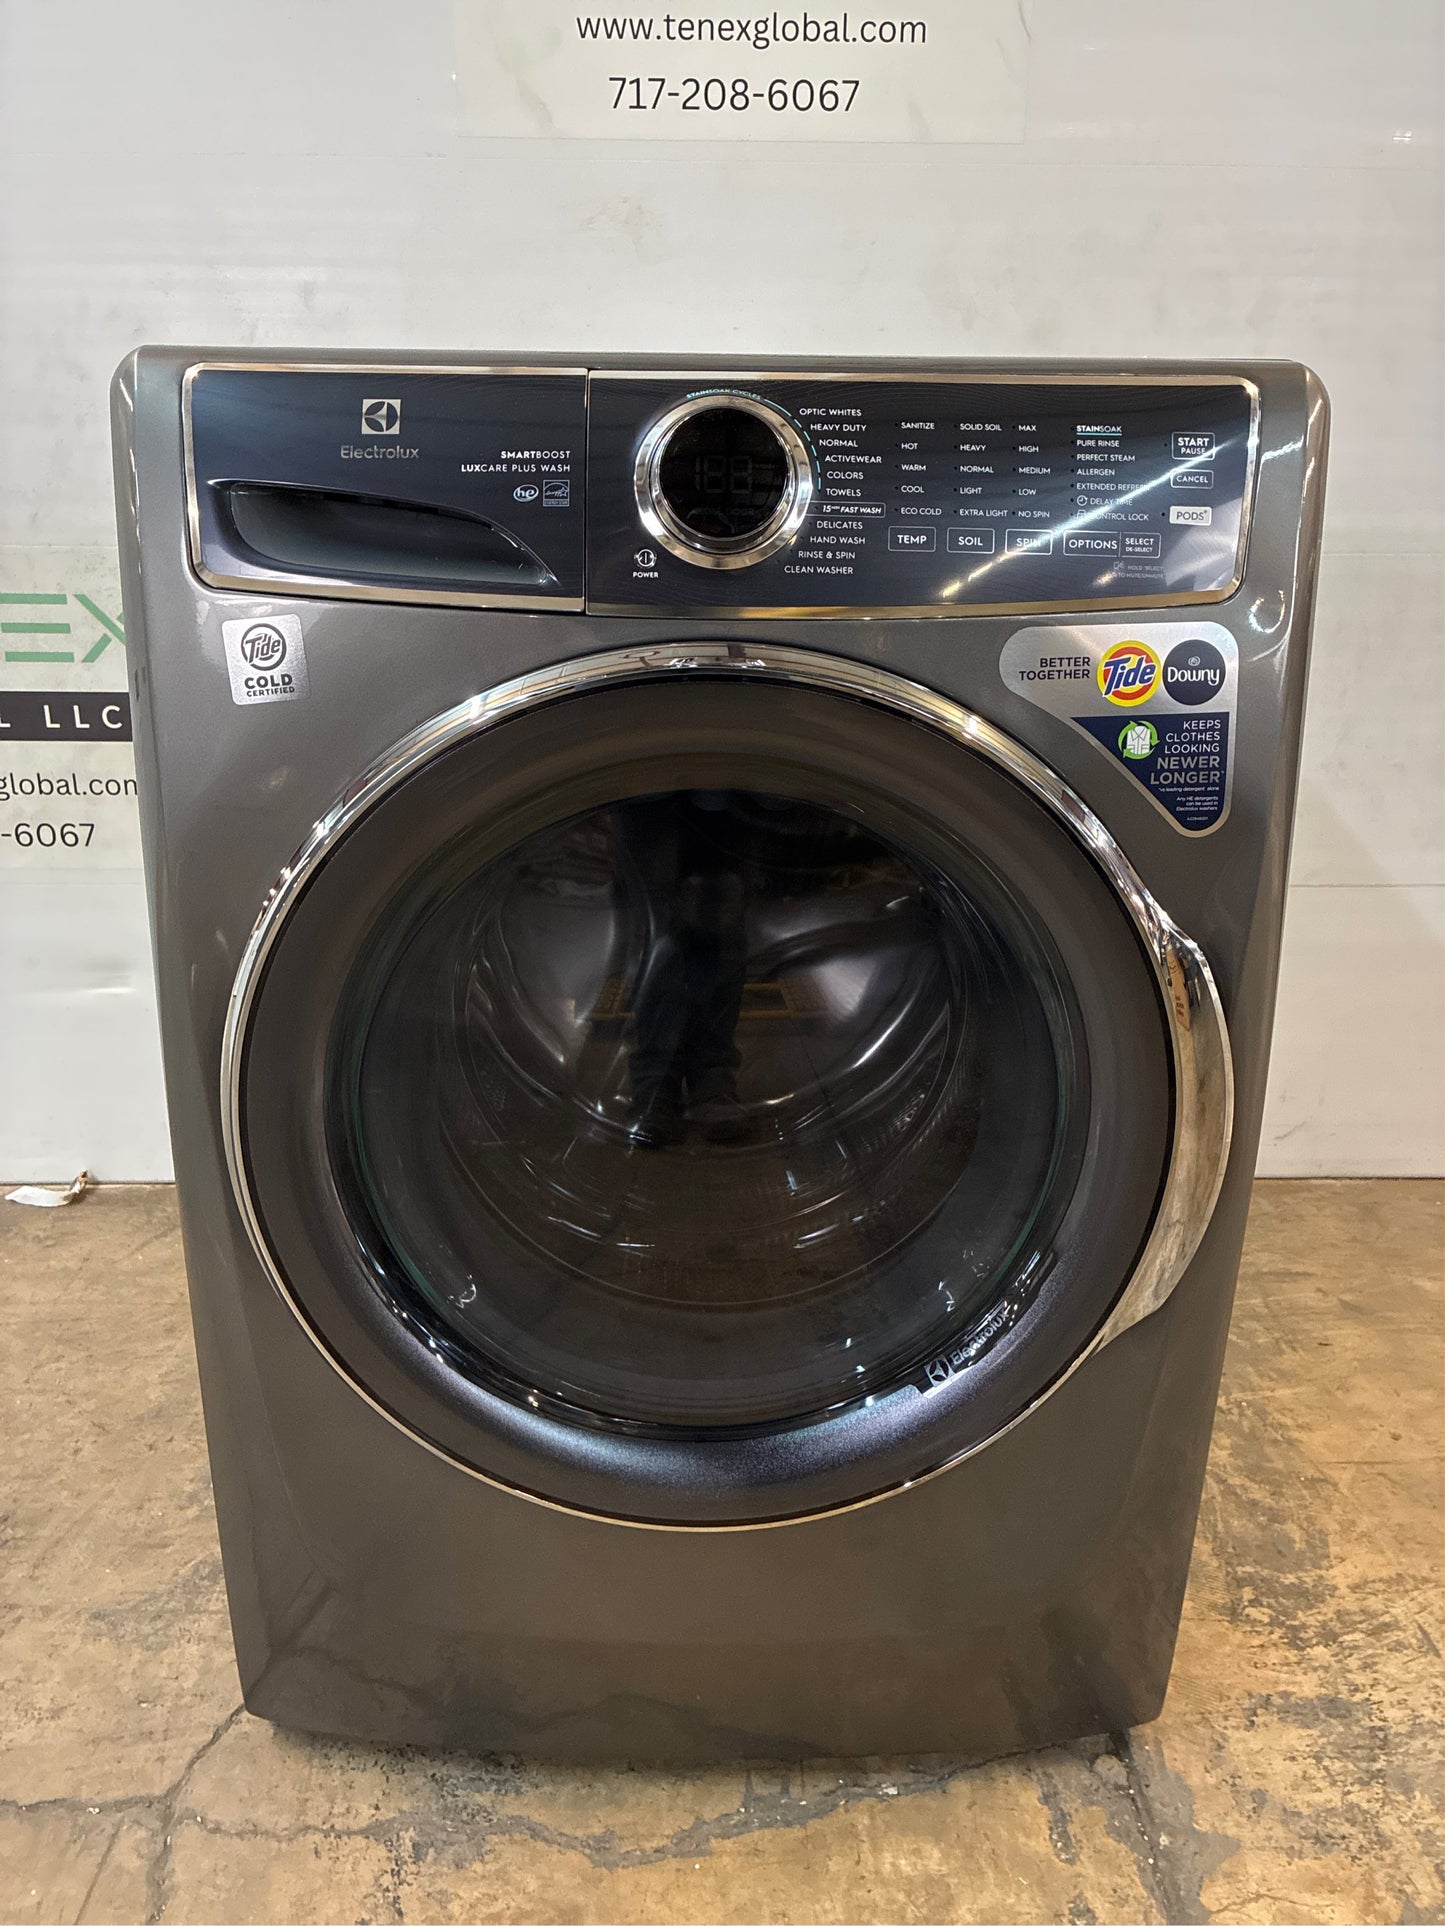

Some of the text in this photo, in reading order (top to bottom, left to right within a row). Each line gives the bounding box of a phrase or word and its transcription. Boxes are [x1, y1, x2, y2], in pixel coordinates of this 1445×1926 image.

[576, 13, 928, 49] www.tenexglobal.com
[608, 77, 860, 112] 717-208-6067
[686, 388, 761, 400] STAINSOAK CYCLES
[800, 408, 862, 417] OPTIC WHITES
[842, 424, 867, 432] DUTY
[901, 422, 935, 430] SANITIZE
[960, 423, 1002, 431] SOLID SOIL
[1018, 424, 1037, 432] MAX
[1076, 424, 1122, 433] STAINSOAK
[819, 439, 858, 448] NORMAL
[901, 442, 918, 450] HOT
[1076, 439, 1120, 448] PURE RINSE
[1178, 437, 1210, 447] START
[340, 445, 420, 459] Electrolux
[960, 444, 986, 452] HEAVY
[1018, 445, 1039, 453] HIGH
[1180, 447, 1206, 455] PAUSE
[500, 450, 571, 459] SMARTBOOST
[1076, 454, 1136, 462] PERFECT STEAM
[824, 455, 882, 464] ACTIVEWEAR
[461, 464, 571, 472] LUXCARE PLUS WASH
[901, 464, 926, 472] WARM
[960, 465, 994, 474] NORMAL
[1018, 466, 1050, 474] MEDIUM
[1076, 468, 1116, 476] ALLERGEN
[826, 471, 864, 480] COLORS
[1176, 475, 1208, 484] CANCEL
[901, 485, 924, 494] COOL
[960, 487, 982, 495] LIGHT
[1076, 482, 1150, 491] EXTENDED REFRE
[826, 488, 862, 497] TOWELS
[1018, 488, 1037, 496] LOW
[1090, 497, 1114, 505] DELAY
[840, 506, 859, 514] FAST
[901, 507, 942, 516] ECO COLD
[960, 509, 1008, 518] EXTRA LIGHT
[1018, 510, 1050, 518] NO SPIN
[1091, 512, 1149, 521] ONTROL LOCK
[816, 521, 864, 530] DELICATES
[810, 536, 866, 545] HAND WASH
[897, 534, 927, 544] TEMP
[958, 536, 983, 546] SOIL
[1016, 538, 1042, 547] SPIN
[1125, 538, 1154, 546] SELECT
[1068, 539, 1118, 550] OPTIONS
[798, 551, 856, 560] RINSE & SPIN
[784, 566, 854, 575] CLEAN WASHER
[244, 632, 281, 663] Tide
[1040, 656, 1090, 668] BETTER
[1019, 669, 1090, 681] TOGETHER
[1102, 655, 1157, 698] Tide
[1167, 666, 1220, 686] Downy
[244, 673, 292, 689] COLD
[246, 686, 296, 698] CERTIFIED
[44, 704, 122, 728] LLC
[1183, 720, 1221, 730] KEEPS
[1166, 731, 1221, 742] CLOTHES
[1164, 743, 1220, 754] LOOKING
[1156, 756, 1220, 770] NEWER
[952, 1311, 1010, 1365] Electrolux
